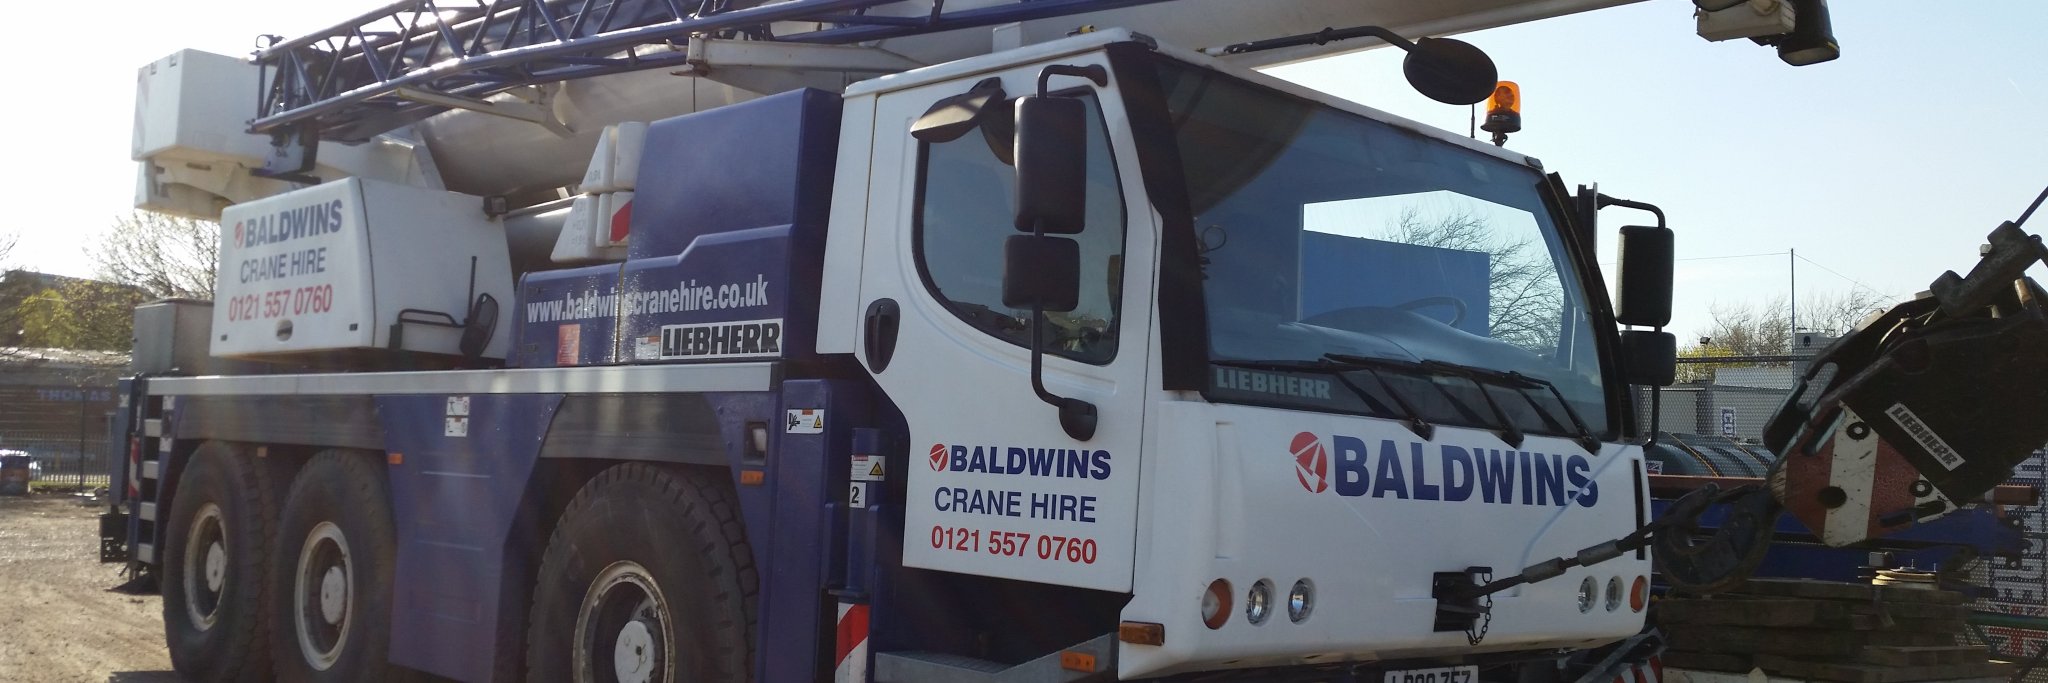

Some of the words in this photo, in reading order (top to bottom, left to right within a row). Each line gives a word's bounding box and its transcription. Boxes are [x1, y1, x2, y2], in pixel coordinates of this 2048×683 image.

[245, 199, 342, 248] BALDWINS
[240, 253, 287, 284] CRANE
[290, 247, 327, 277] HIRE
[228, 294, 260, 322] 0121
[263, 289, 291, 318] 557
[294, 284, 332, 315] 0760
[527, 274, 768, 322] www.baldwinscranehire.co.uk
[662, 323, 780, 356] LIEBHERR
[1216, 367, 1331, 400] LIEBHERR
[1891, 407, 1958, 466] LIEBHERR
[950, 445, 1111, 480] BALDWINS
[1333, 435, 1599, 507] BALDWINS
[850, 486, 860, 504] 2
[934, 486, 1022, 517] CRANE
[1030, 493, 1097, 523] HIRE
[931, 525, 980, 552] 0121
[988, 530, 1031, 557] 557
[1037, 535, 1097, 564] 0760
